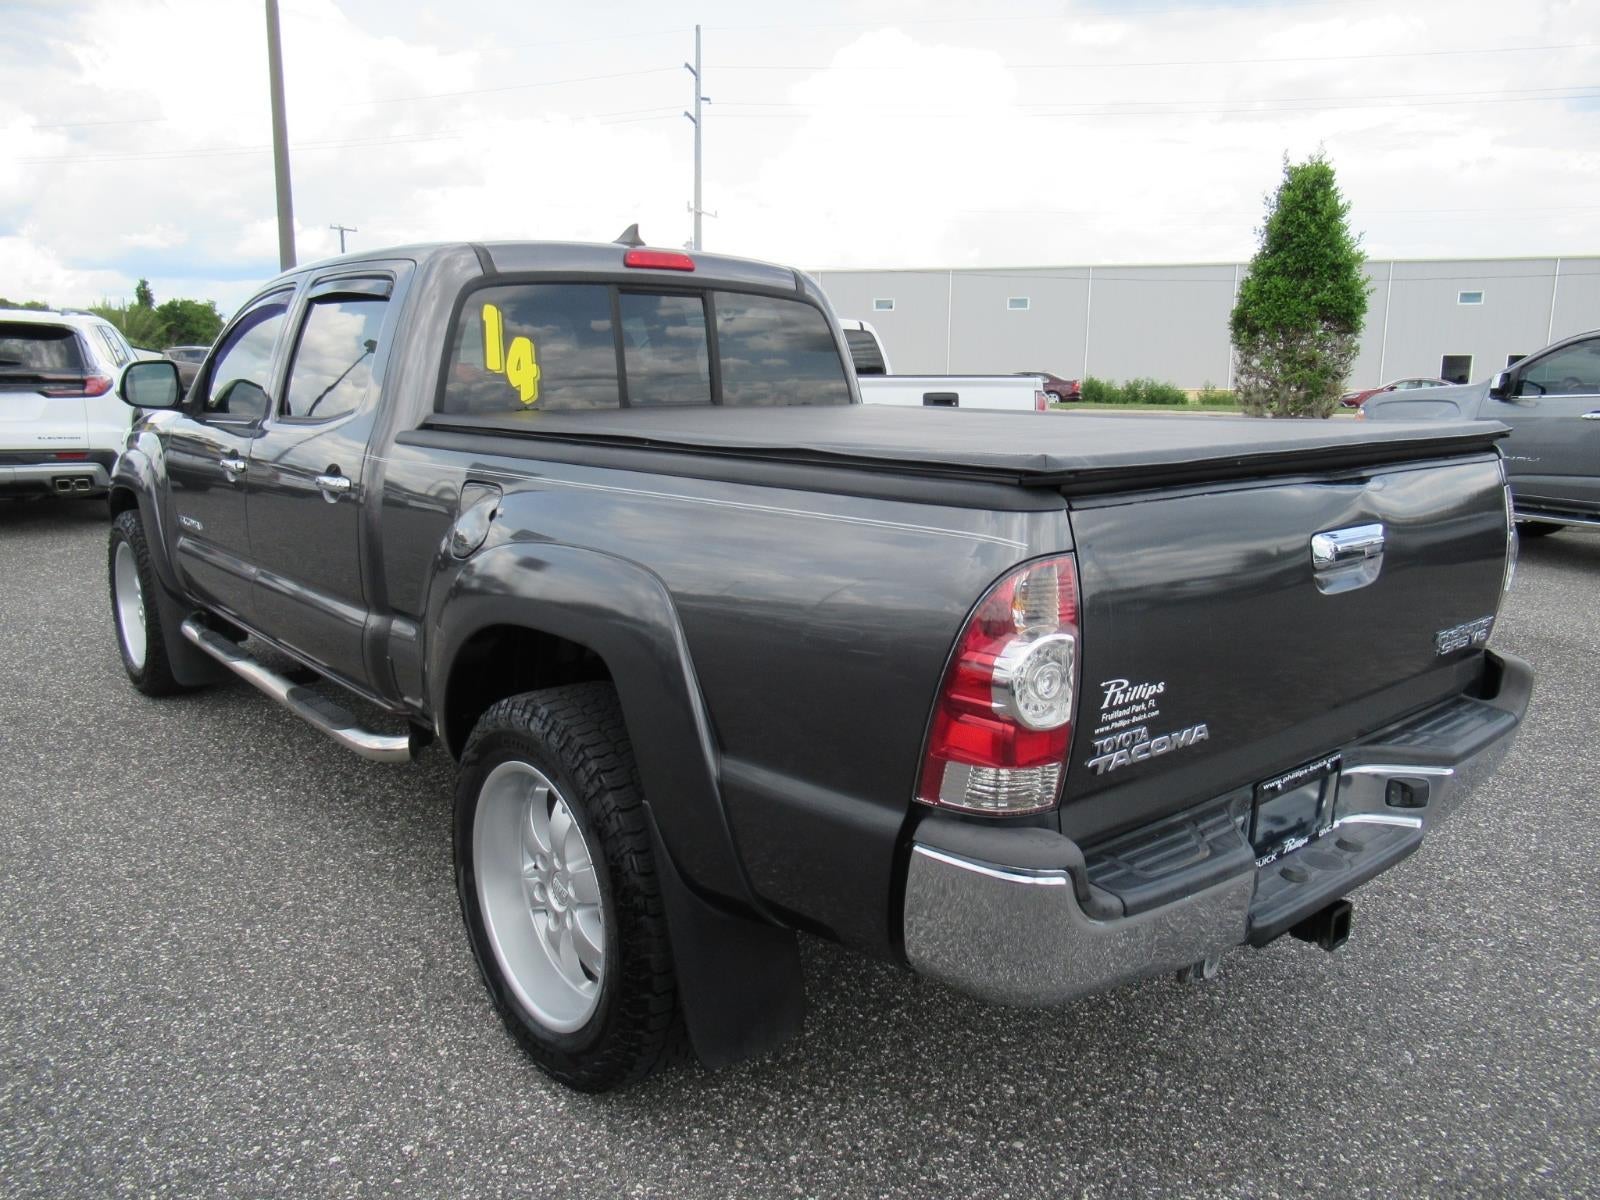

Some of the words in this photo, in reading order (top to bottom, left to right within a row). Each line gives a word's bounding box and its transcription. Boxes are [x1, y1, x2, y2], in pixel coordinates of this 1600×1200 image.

[1100, 679, 1165, 709] Phillips
[1101, 706, 1130, 722] Fruitland
[1148, 699, 1156, 708] FL
[1087, 724, 1209, 775] TACOMA
[1094, 726, 1149, 756] TOYOTA
